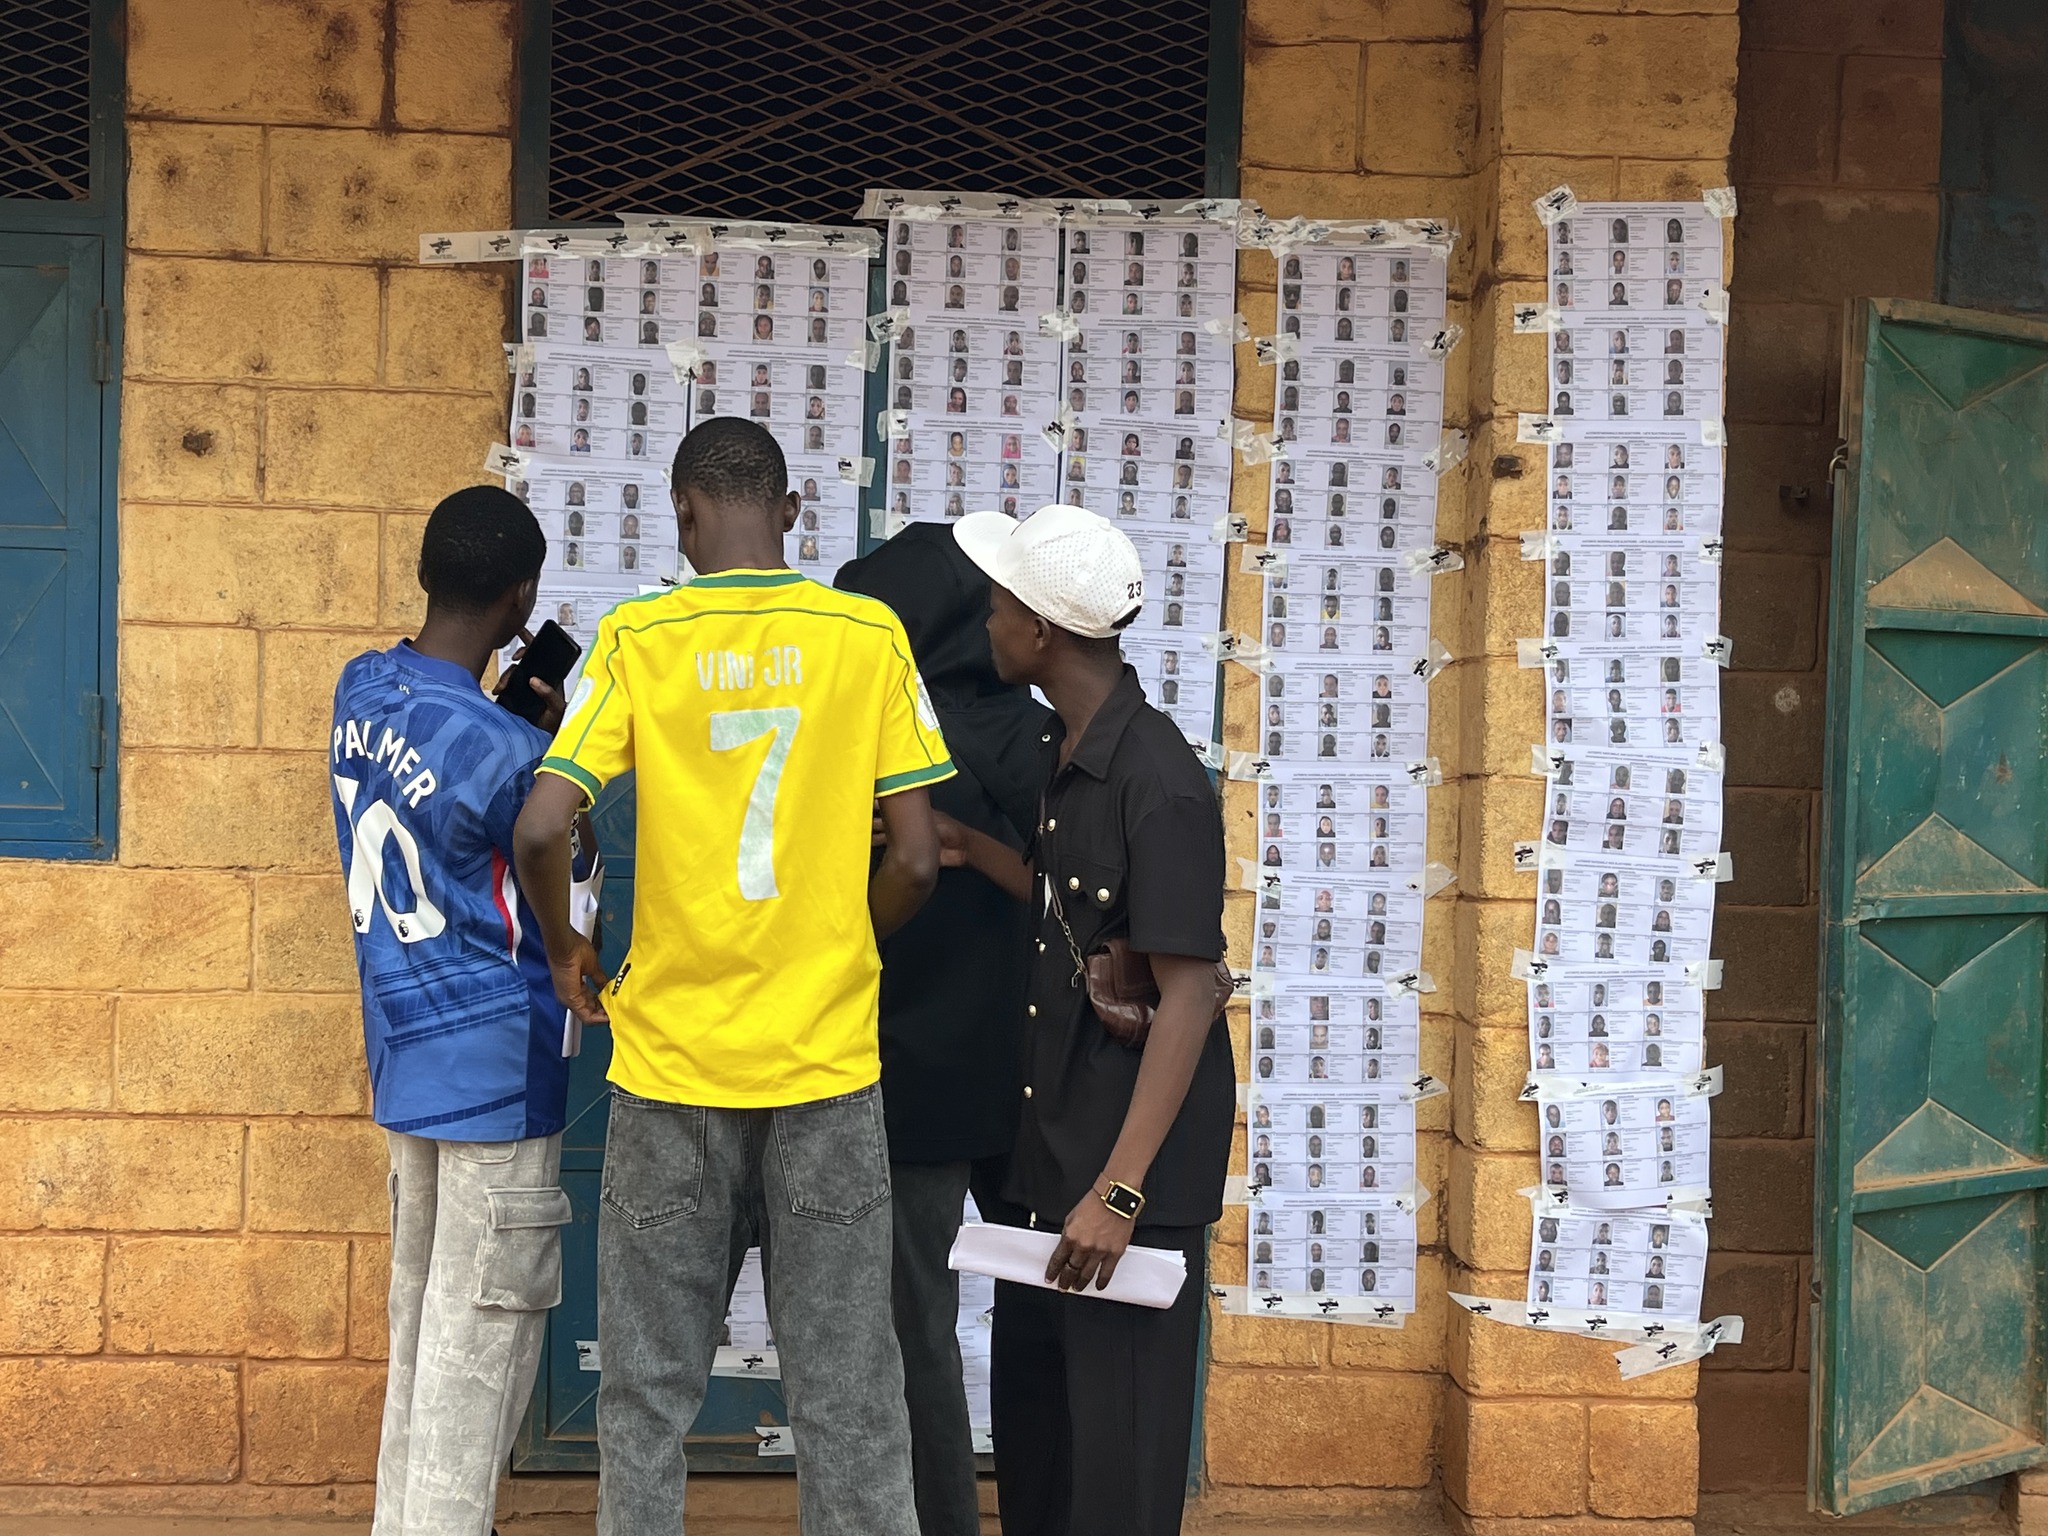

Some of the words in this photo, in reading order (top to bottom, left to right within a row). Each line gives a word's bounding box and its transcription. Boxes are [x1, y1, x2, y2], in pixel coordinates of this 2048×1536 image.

[1126, 580, 1143, 600] 23
[762, 645, 803, 687] JR
[333, 719, 437, 809] PALMER
[709, 706, 801, 901] 7
